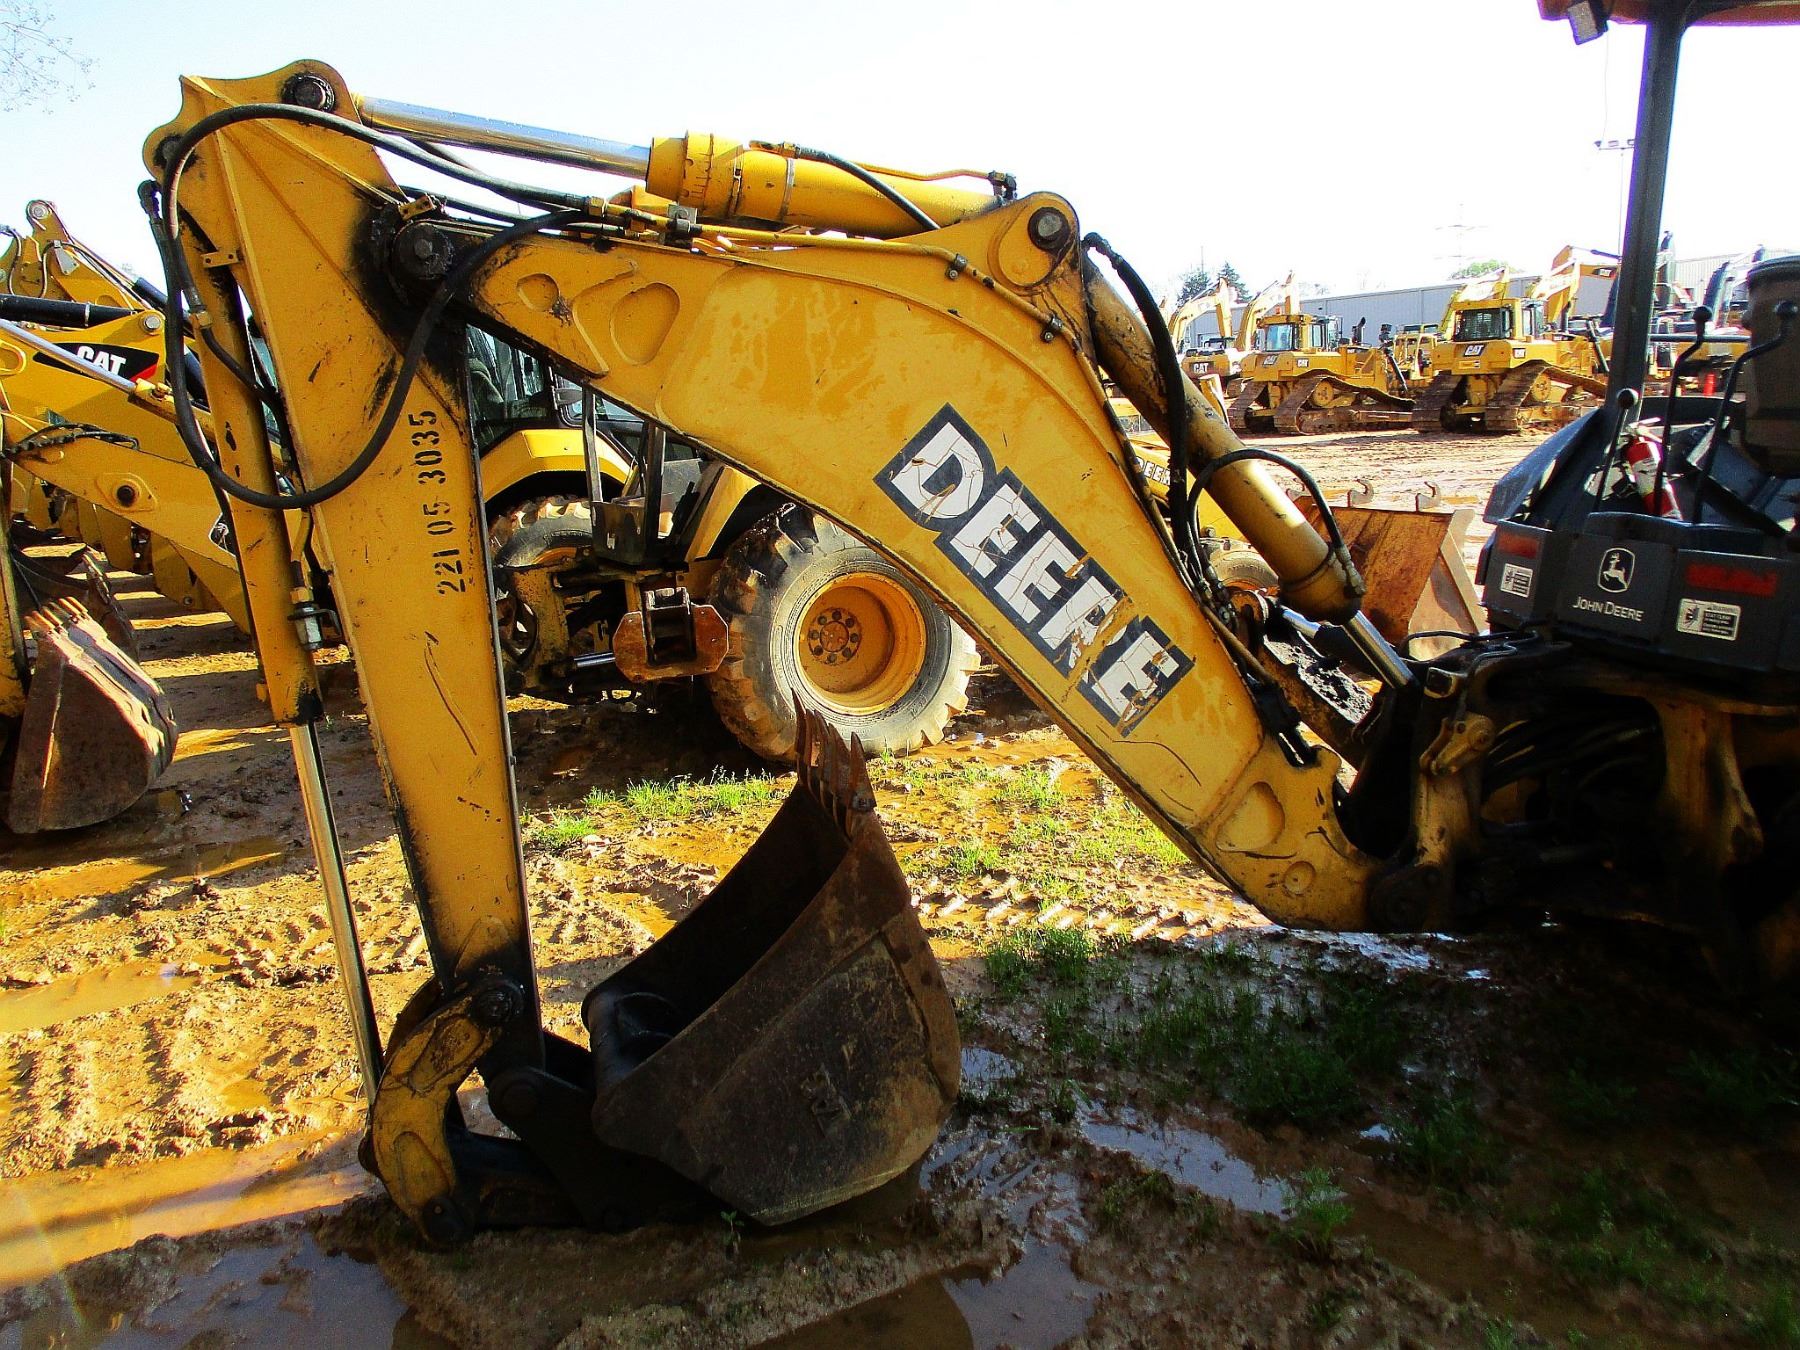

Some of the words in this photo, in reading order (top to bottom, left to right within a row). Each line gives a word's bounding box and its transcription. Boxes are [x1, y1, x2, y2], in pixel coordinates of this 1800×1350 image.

[77, 345, 126, 375] CAT
[1465, 345, 1484, 356] CAT
[1193, 362, 1209, 374] CAT
[408, 410, 447, 485] 3035
[423, 502, 453, 536] 05
[432, 549, 466, 595] 221
[1572, 596, 1604, 613] JOHN
[1604, 601, 1645, 622] DEERE
